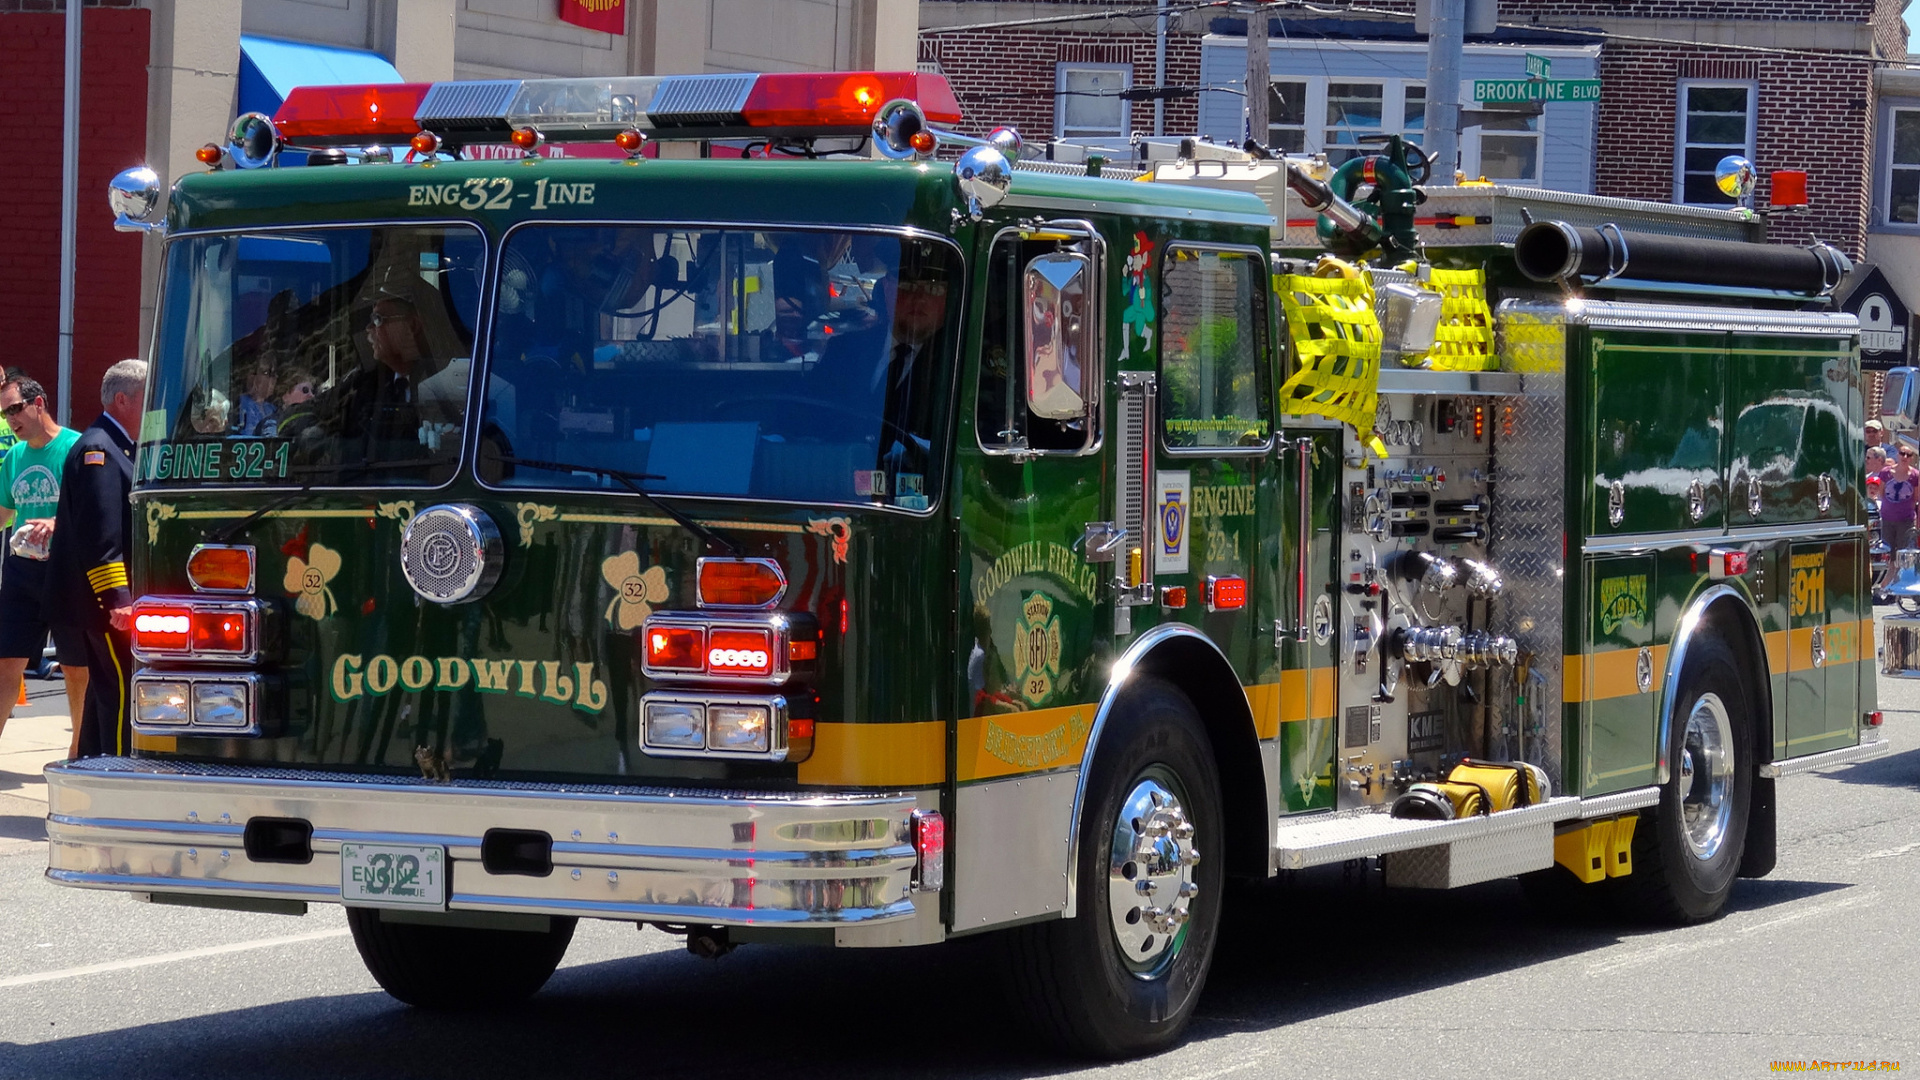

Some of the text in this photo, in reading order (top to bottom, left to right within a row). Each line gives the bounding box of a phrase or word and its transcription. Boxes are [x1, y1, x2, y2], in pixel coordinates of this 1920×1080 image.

[1476, 82, 1600, 99] BROOKLINE BLVD
[134, 442, 289, 481] NGINE 32-1
[874, 473, 883, 493] 12
[1193, 485, 1256, 517] ENGINE
[1207, 529, 1240, 561] 32-1
[304, 575, 322, 588] 32
[976, 540, 1044, 606] GOODWILL
[1049, 541, 1078, 583] FIRE
[624, 583, 643, 597] 32
[1796, 568, 1825, 616] 911
[1027, 603, 1049, 620] STATION
[1029, 628, 1047, 670] BFD
[1828, 626, 1852, 661] 32-1
[331, 654, 607, 714] GOODWILL
[1030, 680, 1045, 694] 32
[1411, 715, 1443, 739] KME
[367, 853, 420, 896] 32
[426, 870, 433, 885] 1
